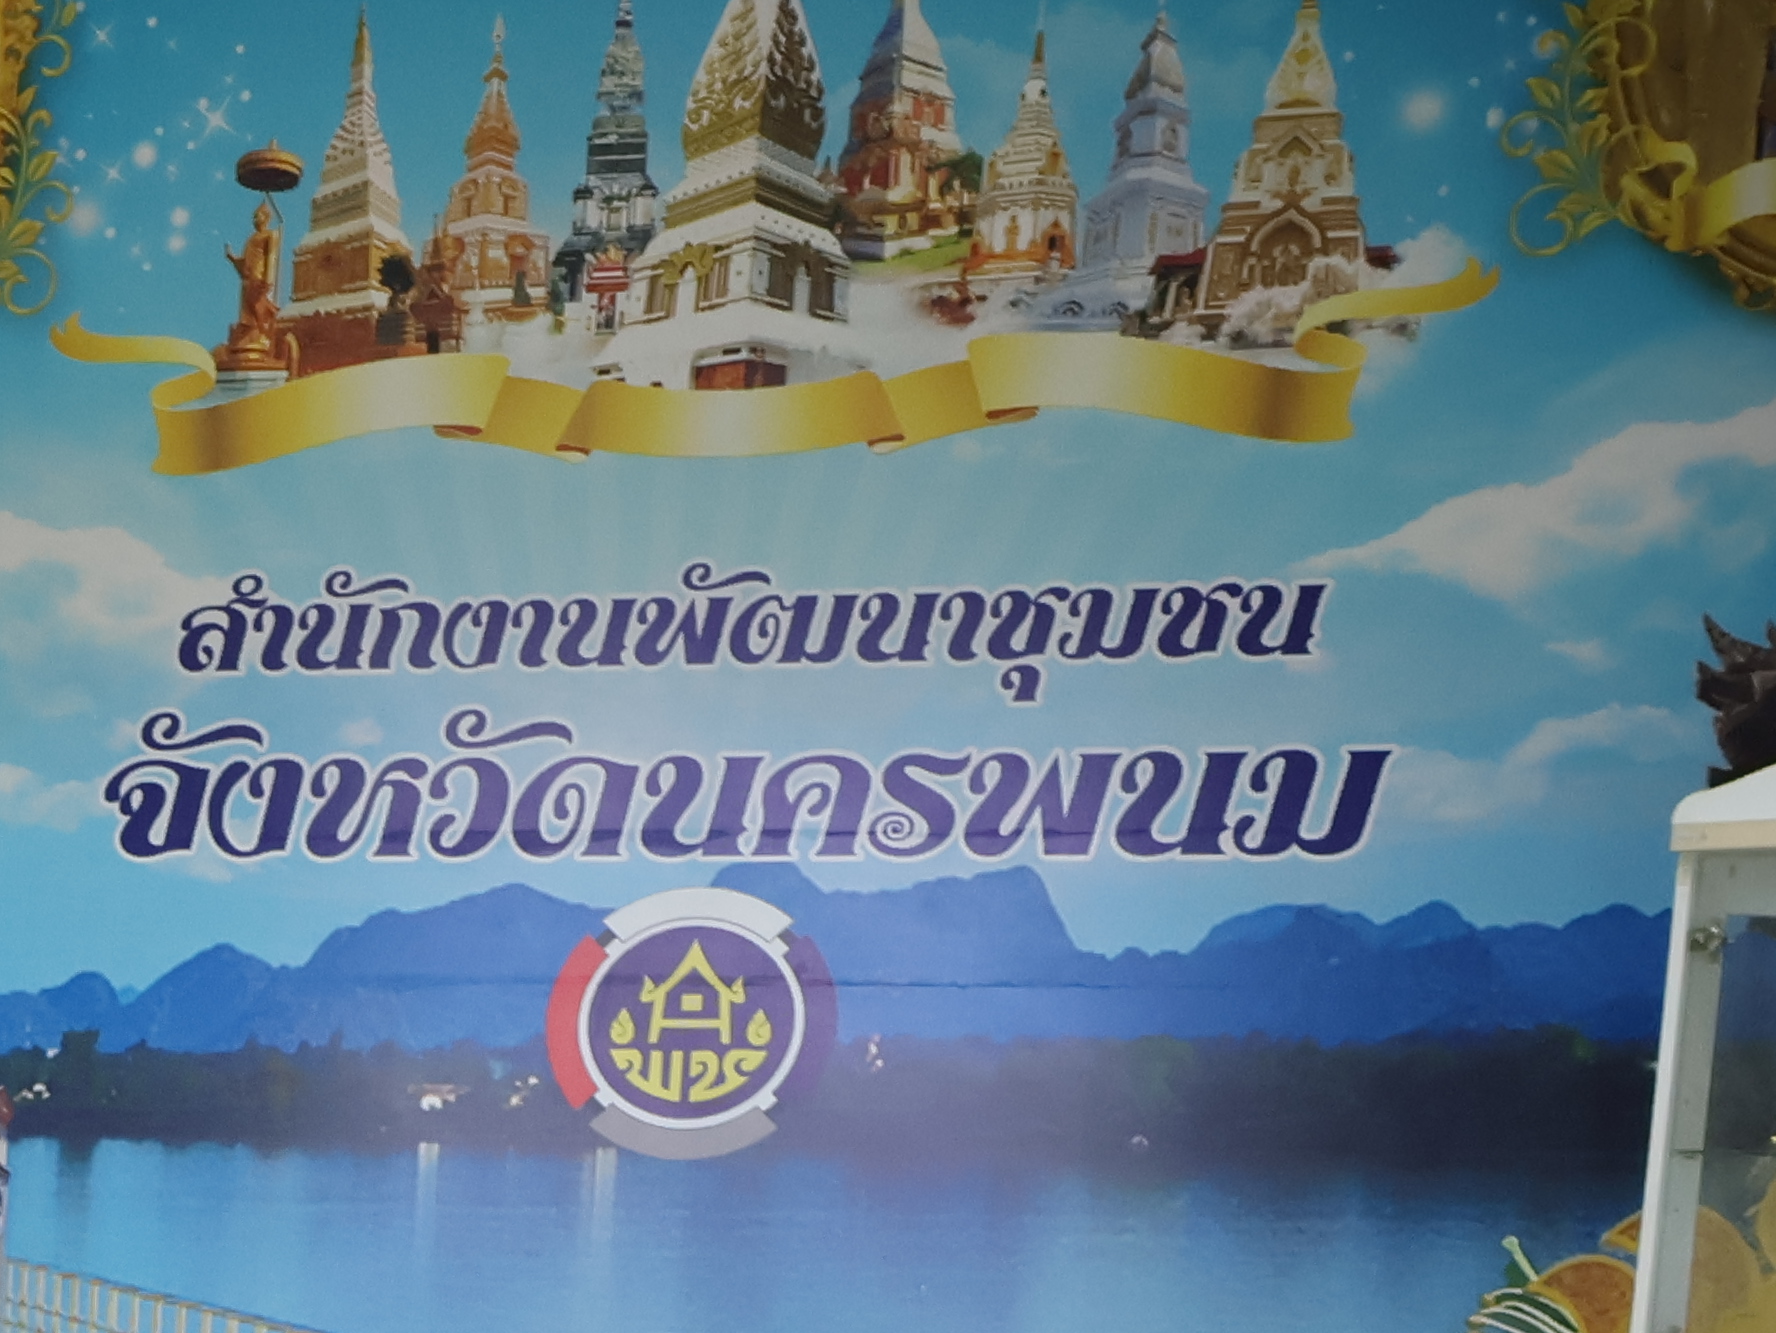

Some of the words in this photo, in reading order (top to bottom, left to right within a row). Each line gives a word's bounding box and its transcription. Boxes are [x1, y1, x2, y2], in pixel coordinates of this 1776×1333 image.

[179, 563, 1330, 704] สำนักงานพัฒนาชุมชน
[104, 712, 1391, 859] จังหวัดนครพนม
